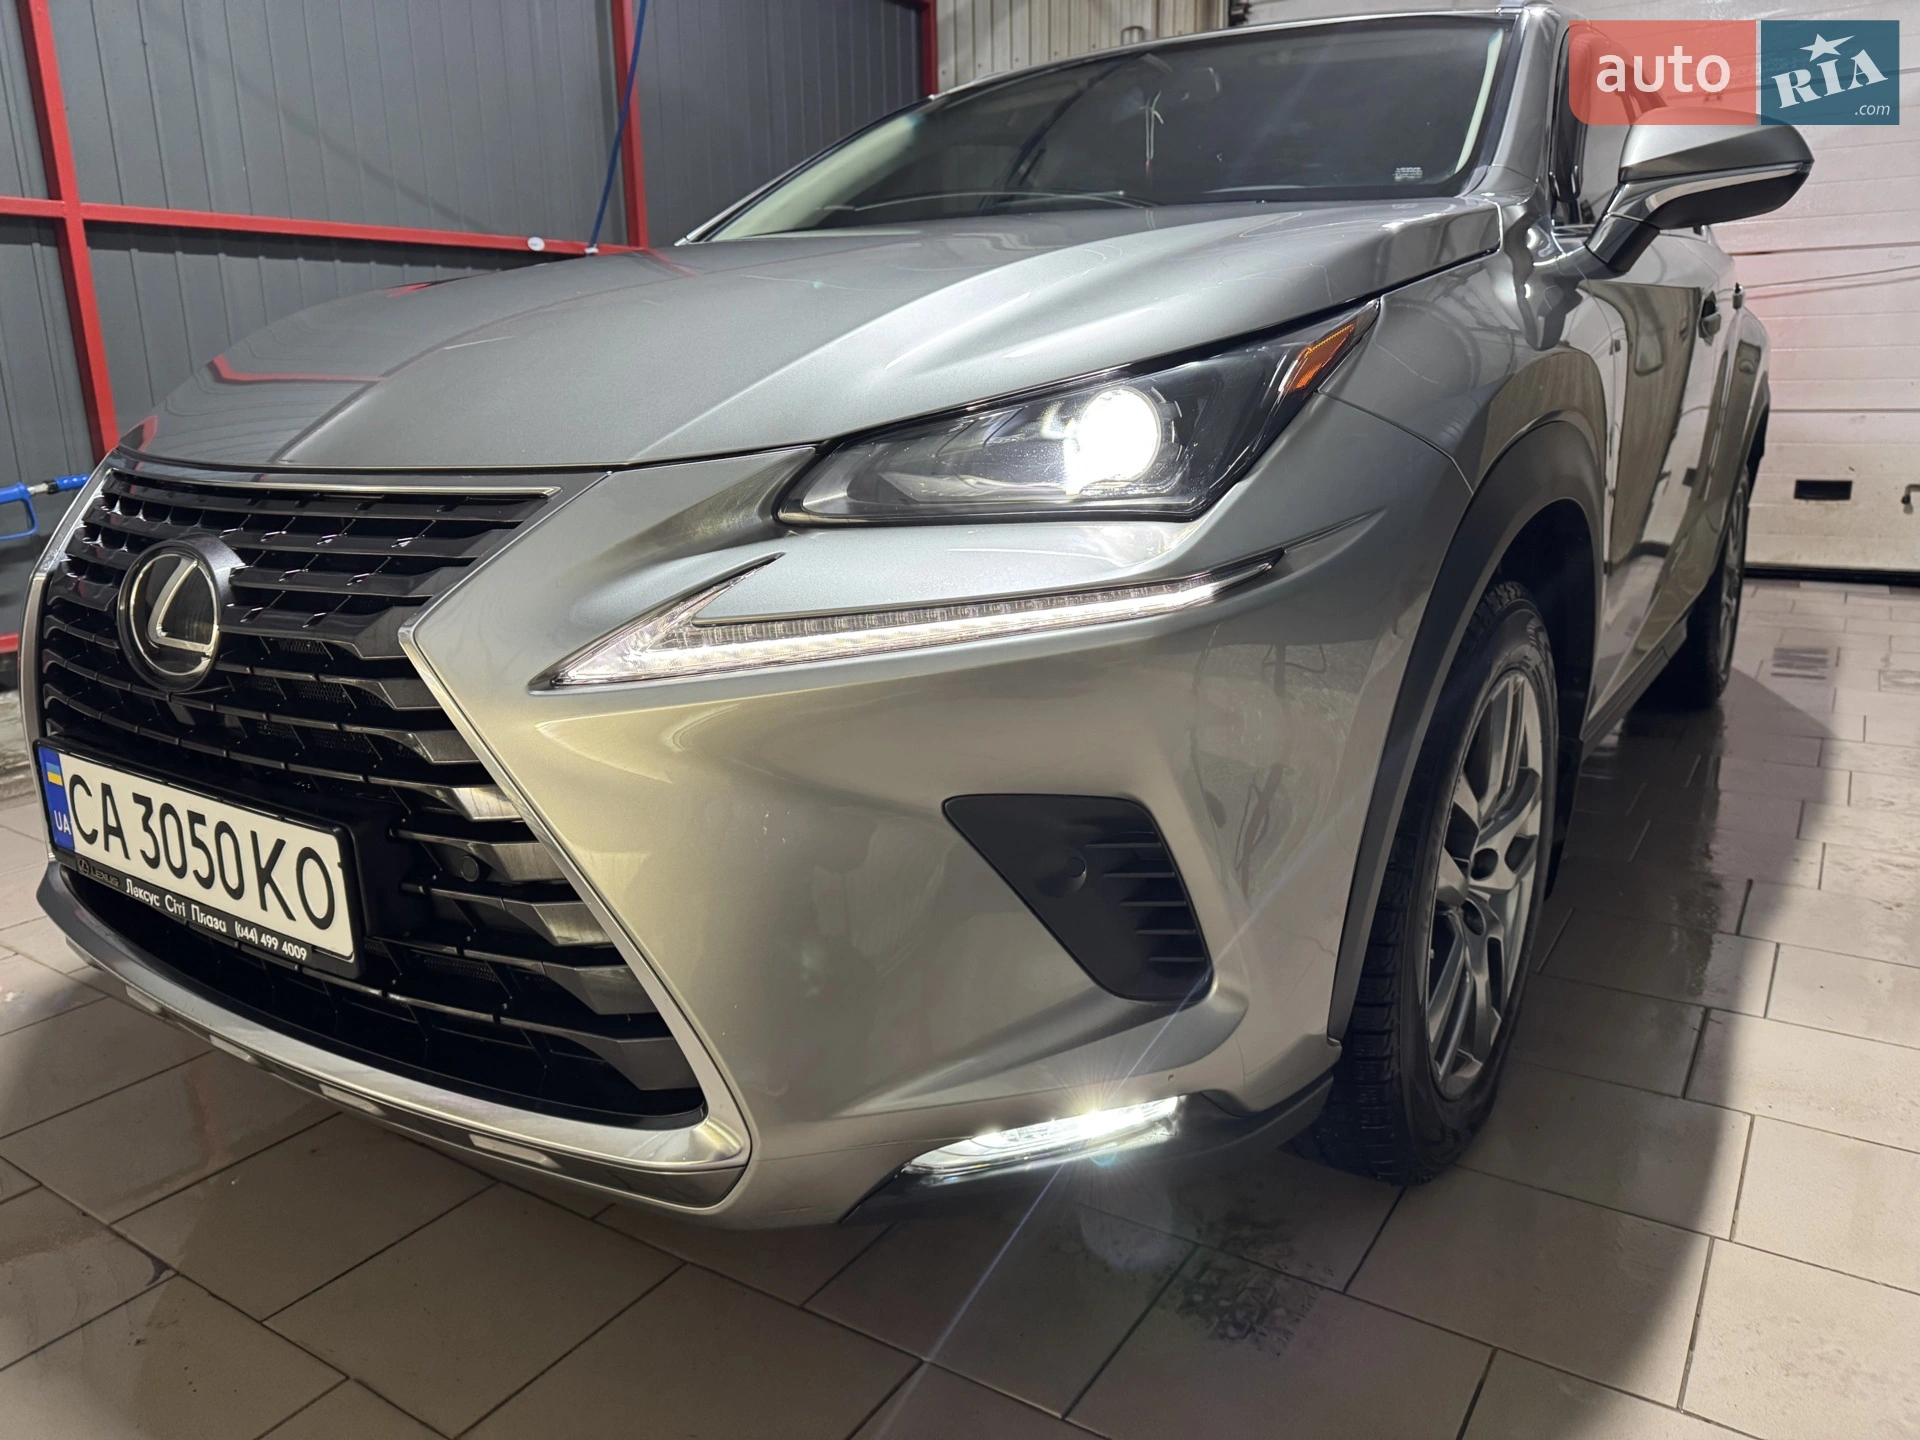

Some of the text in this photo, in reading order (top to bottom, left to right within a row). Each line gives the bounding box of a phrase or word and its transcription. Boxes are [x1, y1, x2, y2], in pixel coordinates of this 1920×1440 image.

[53, 809, 72, 836] UA
[126, 878, 161, 907] Лексус
[190, 903, 228, 933] Плаза
[260, 933, 279, 951] 499
[281, 941, 308, 961] 4009
